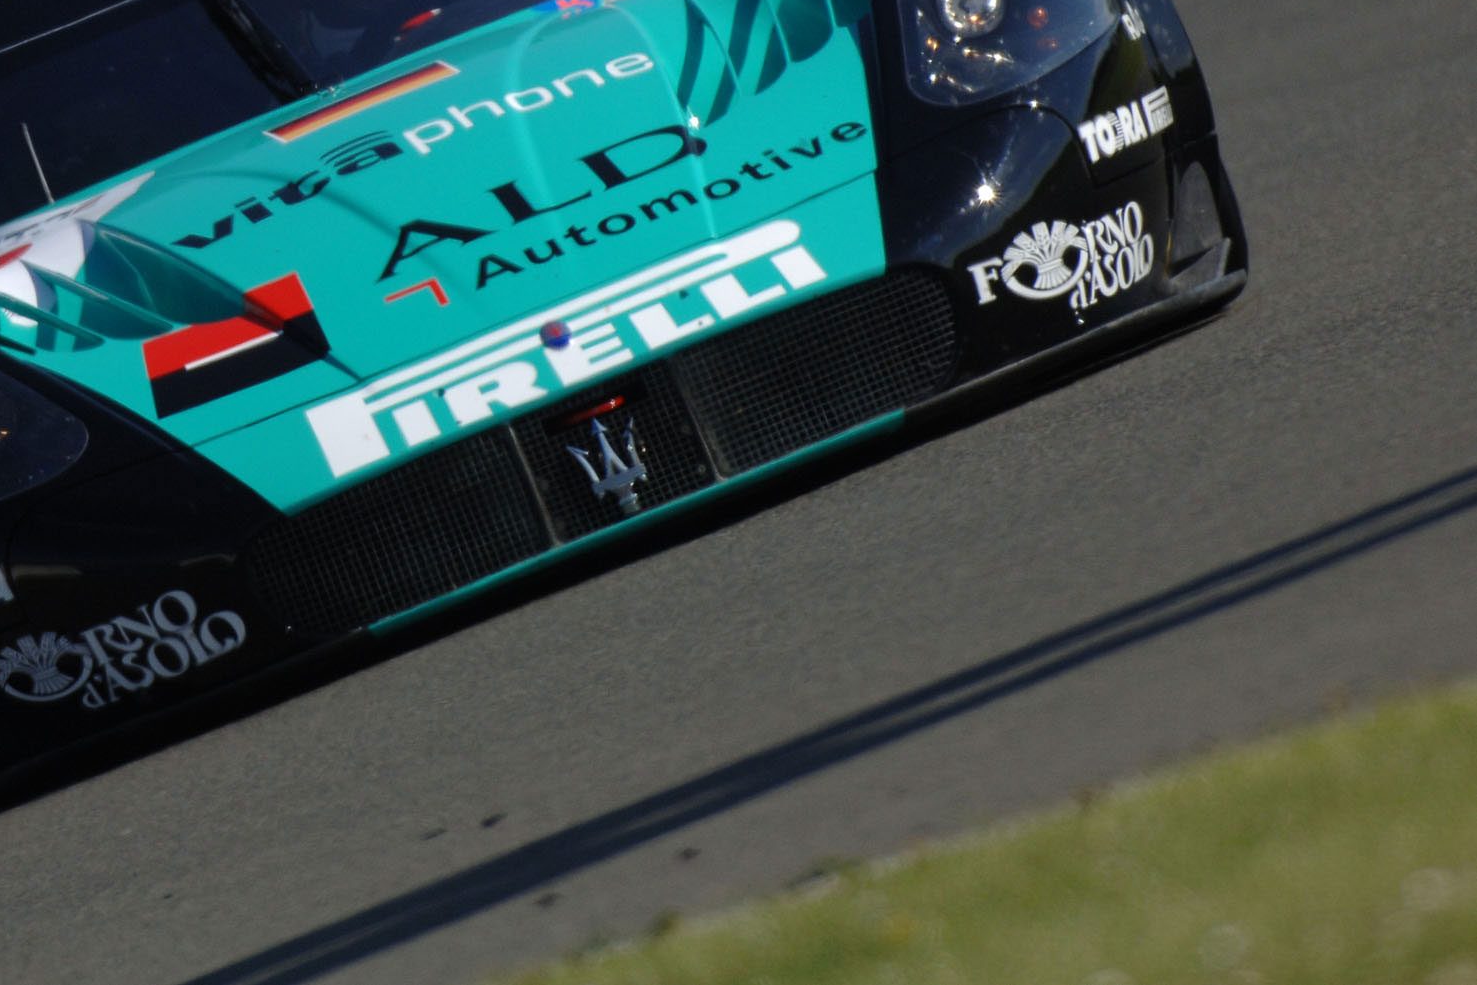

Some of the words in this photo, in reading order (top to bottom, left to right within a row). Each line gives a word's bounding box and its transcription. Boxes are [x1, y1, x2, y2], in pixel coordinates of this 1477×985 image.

[374, 123, 709, 284] ALD
[474, 120, 868, 291] Automotive
[304, 218, 828, 479] PIRELLI
